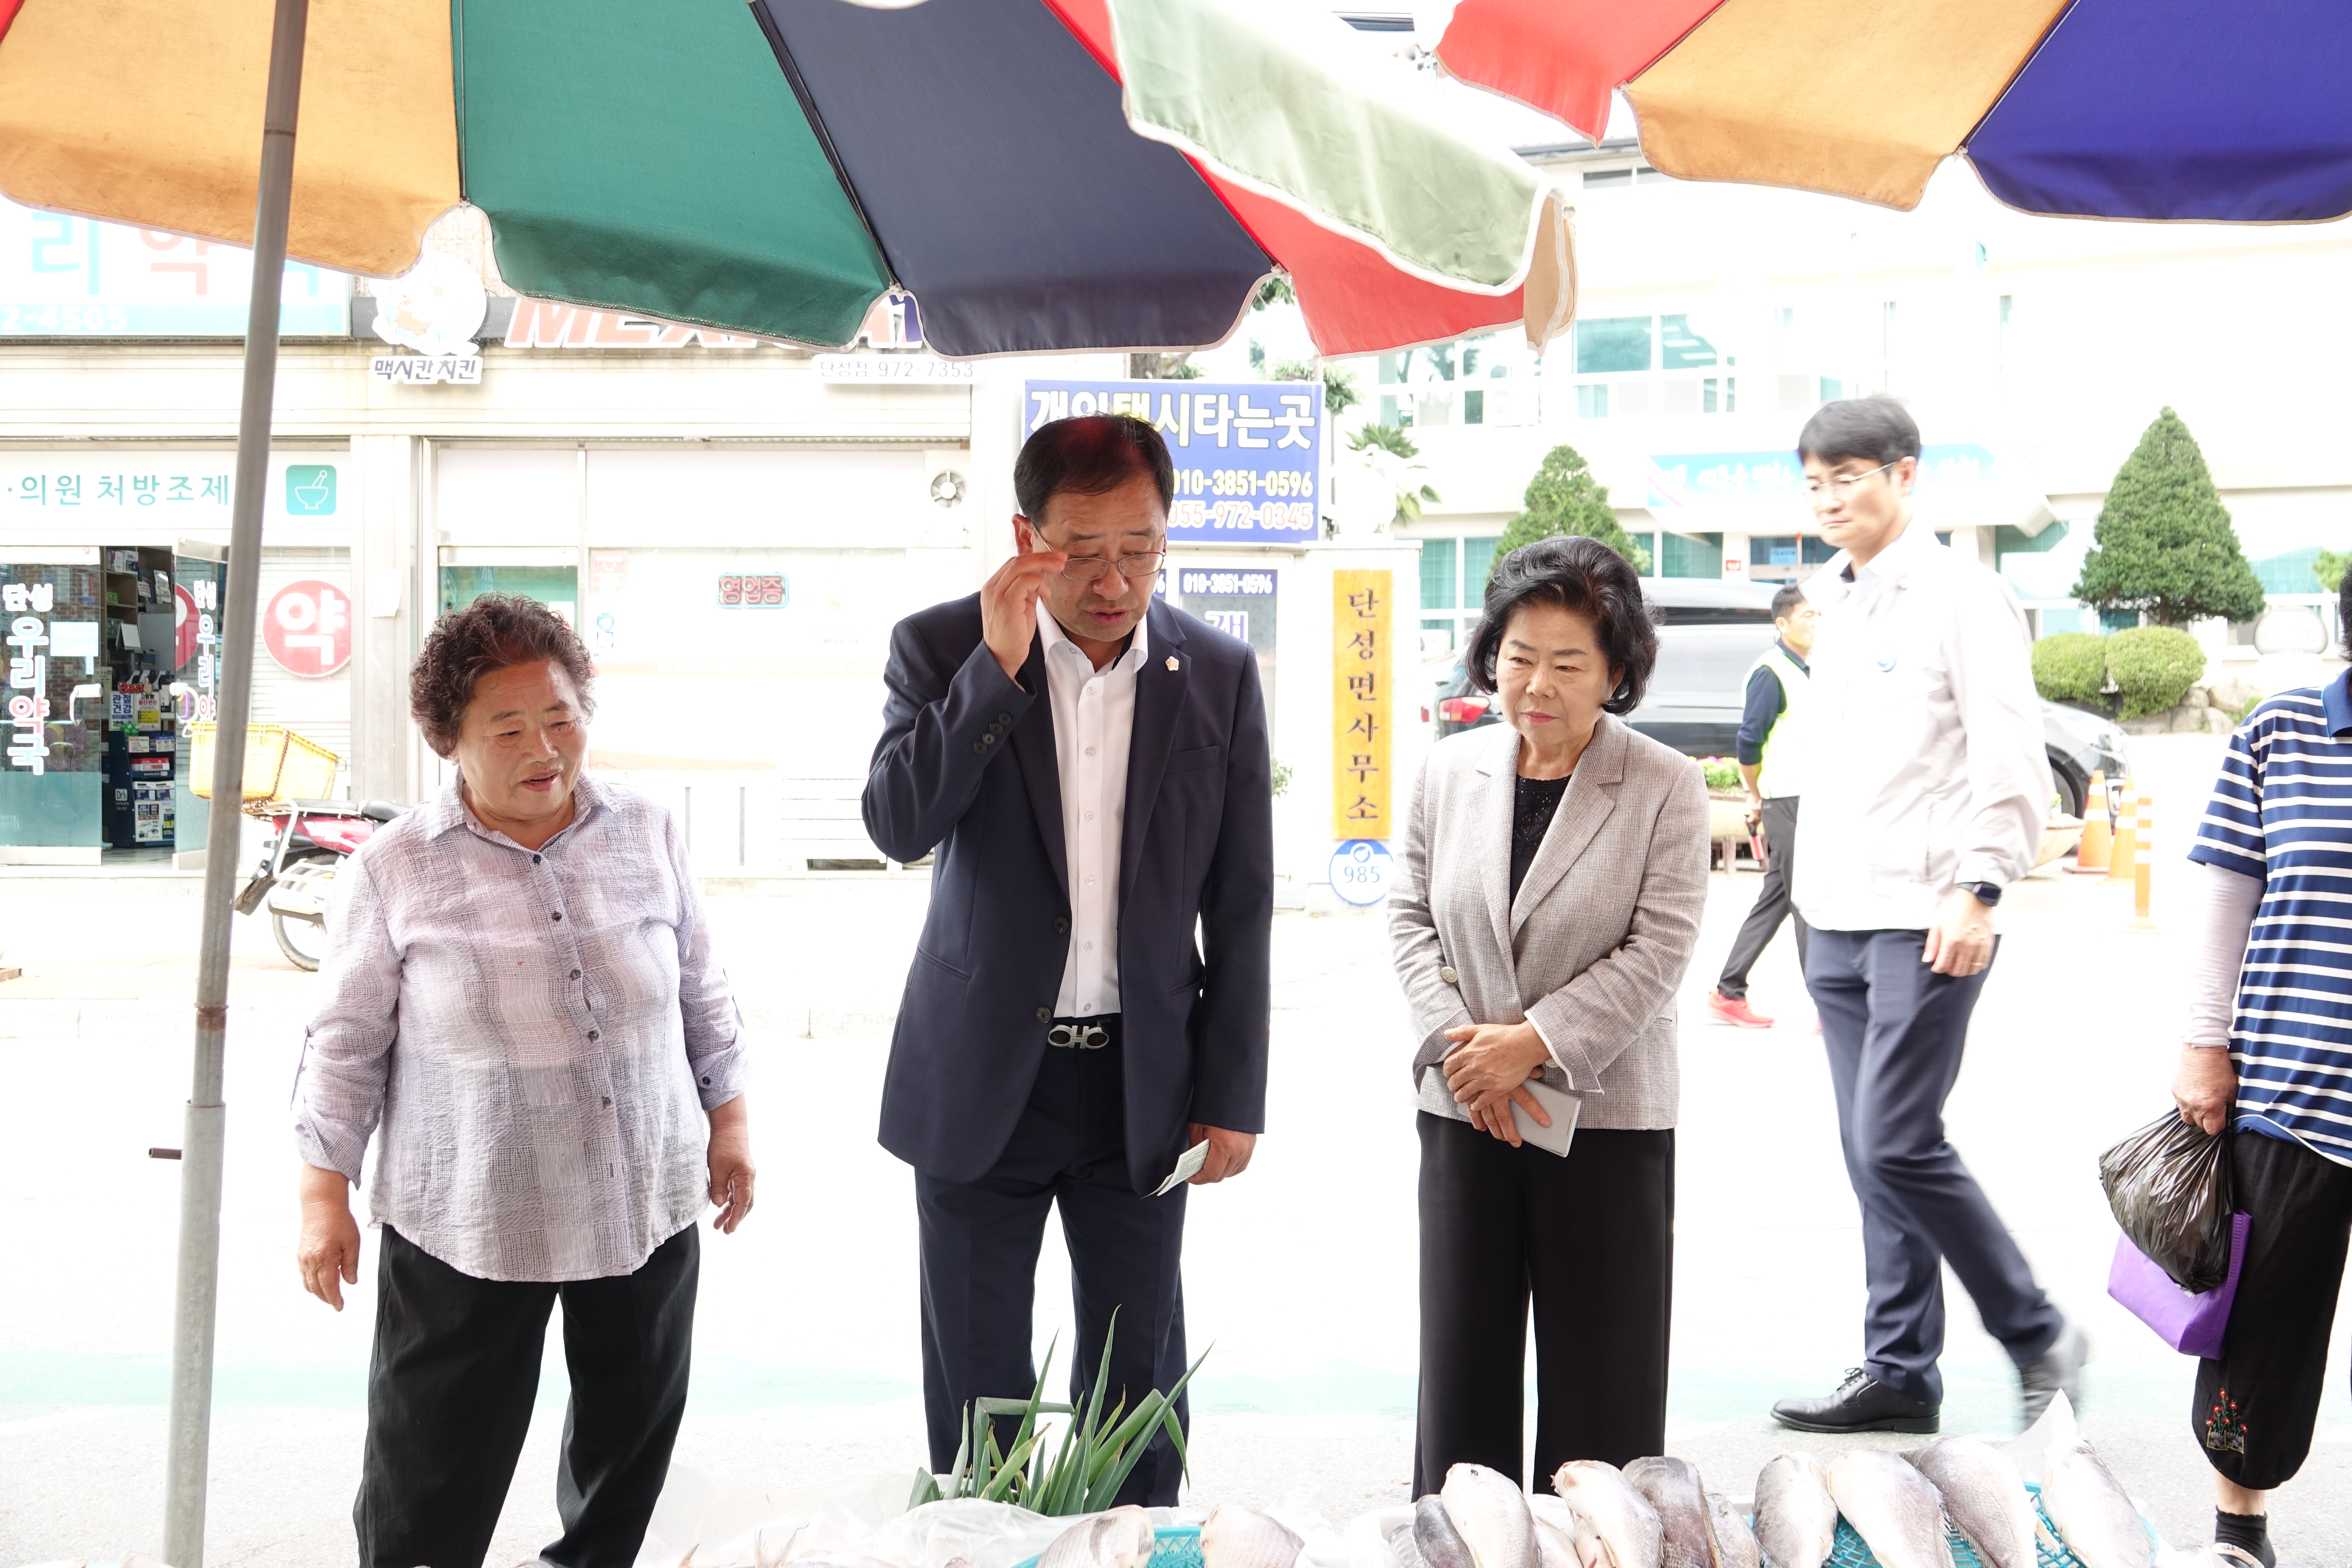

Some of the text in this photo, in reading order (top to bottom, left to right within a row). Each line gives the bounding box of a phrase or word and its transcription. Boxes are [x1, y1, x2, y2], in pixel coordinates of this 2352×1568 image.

[821, 361, 974, 377] 단성점 972-7353
[97, 475, 229, 506] 처방조제
[1167, 499, 1314, 530] 055-972-0345
[2, 583, 53, 612] 단성
[194, 579, 216, 610] 단성
[720, 576, 782, 605] 영업중
[1183, 573, 1273, 594] 010-3851-0596
[276, 590, 345, 665] 약
[119, 682, 144, 694] Best
[1346, 588, 1379, 821] 단성면사무소
[1344, 866, 1380, 883] 985
